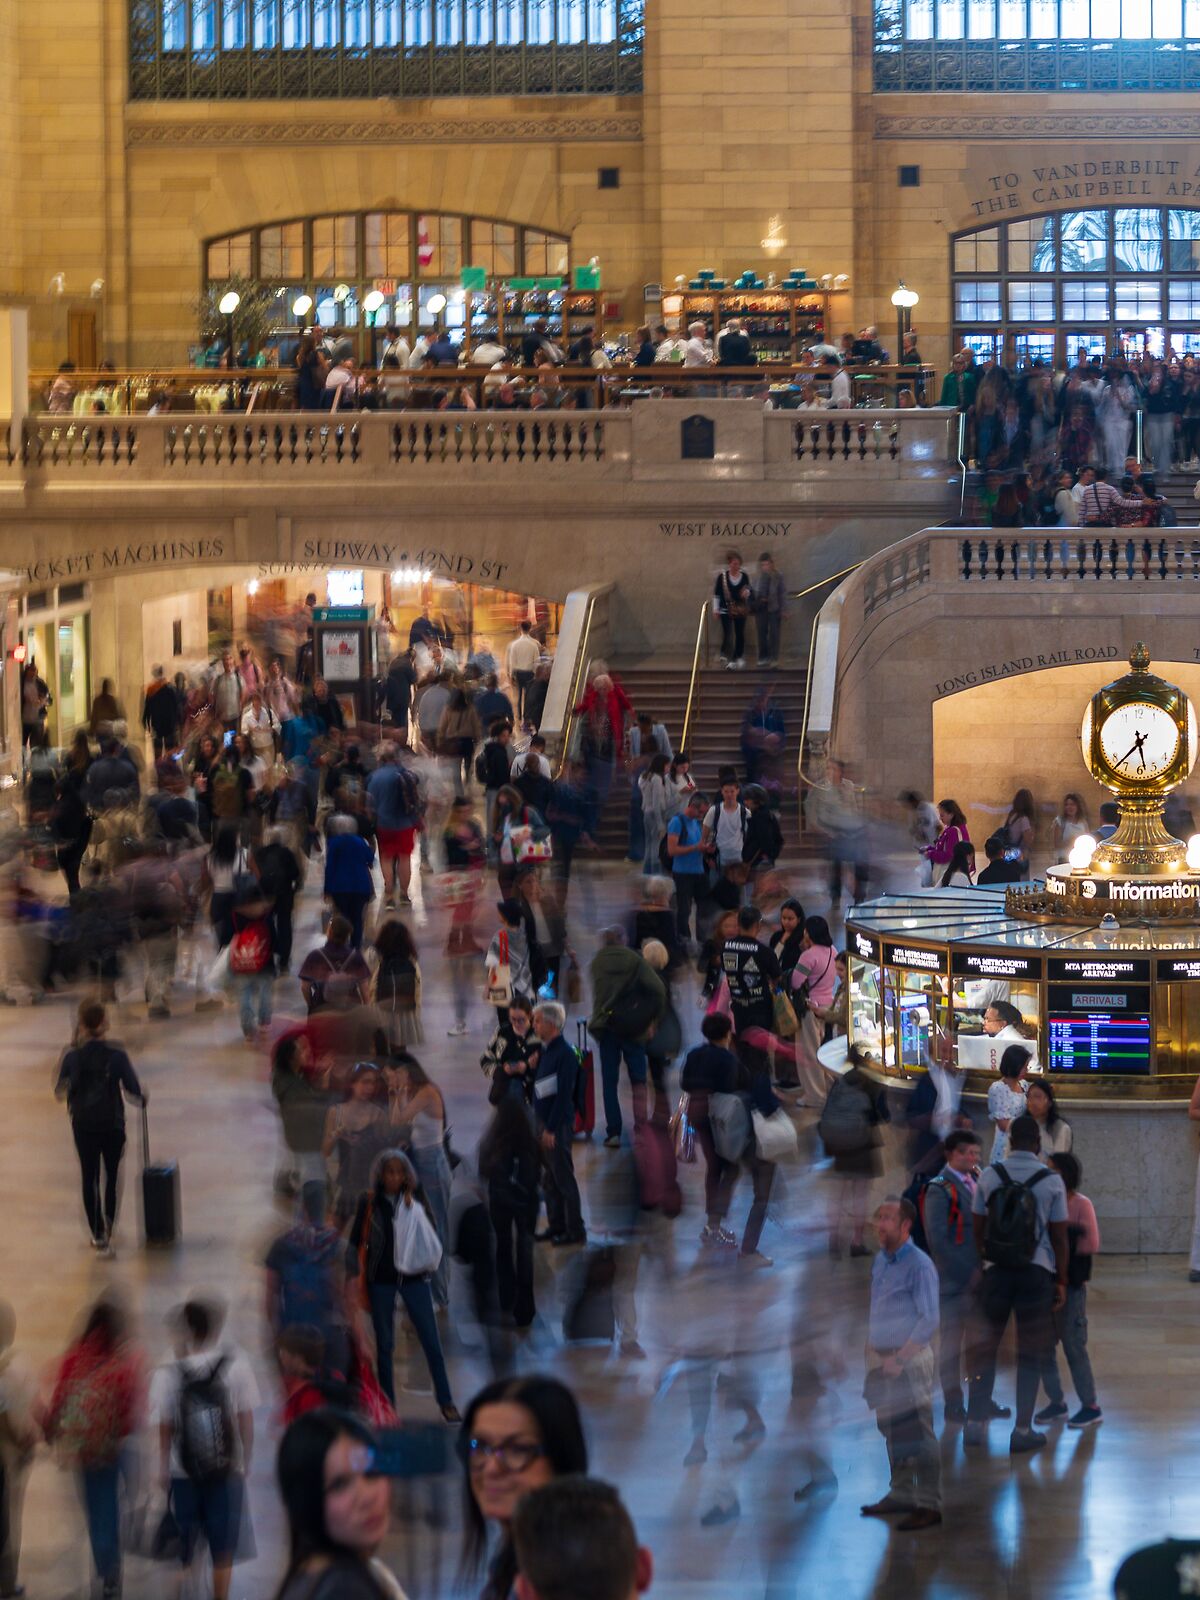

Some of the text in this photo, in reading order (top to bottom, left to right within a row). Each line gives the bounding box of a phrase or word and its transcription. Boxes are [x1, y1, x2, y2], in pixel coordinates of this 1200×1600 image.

[989, 172, 1019, 192] TO
[1033, 160, 1180, 183] VANDERBILT
[972, 193, 1019, 216] THE
[1032, 180, 1152, 203] CAMPBELL
[659, 522, 792, 537] WEST BALCONY
[12, 537, 225, 584] ICKET MACHINES
[303, 539, 510, 581] SUBWAY 42ND ST
[935, 645, 1118, 695] LONG ISLAND RAIL ROAD
[1136, 765, 1143, 775] 6
[1109, 880, 1200, 900] Information
[967, 957, 1028, 969] MTA METRO-NORTH
[1065, 962, 1133, 971] MTA METRO-NORTH
[1173, 962, 1188, 971] MTA
[1082, 969, 1116, 978] ARRIVALS
[1074, 995, 1124, 1006] ARRIVALS
